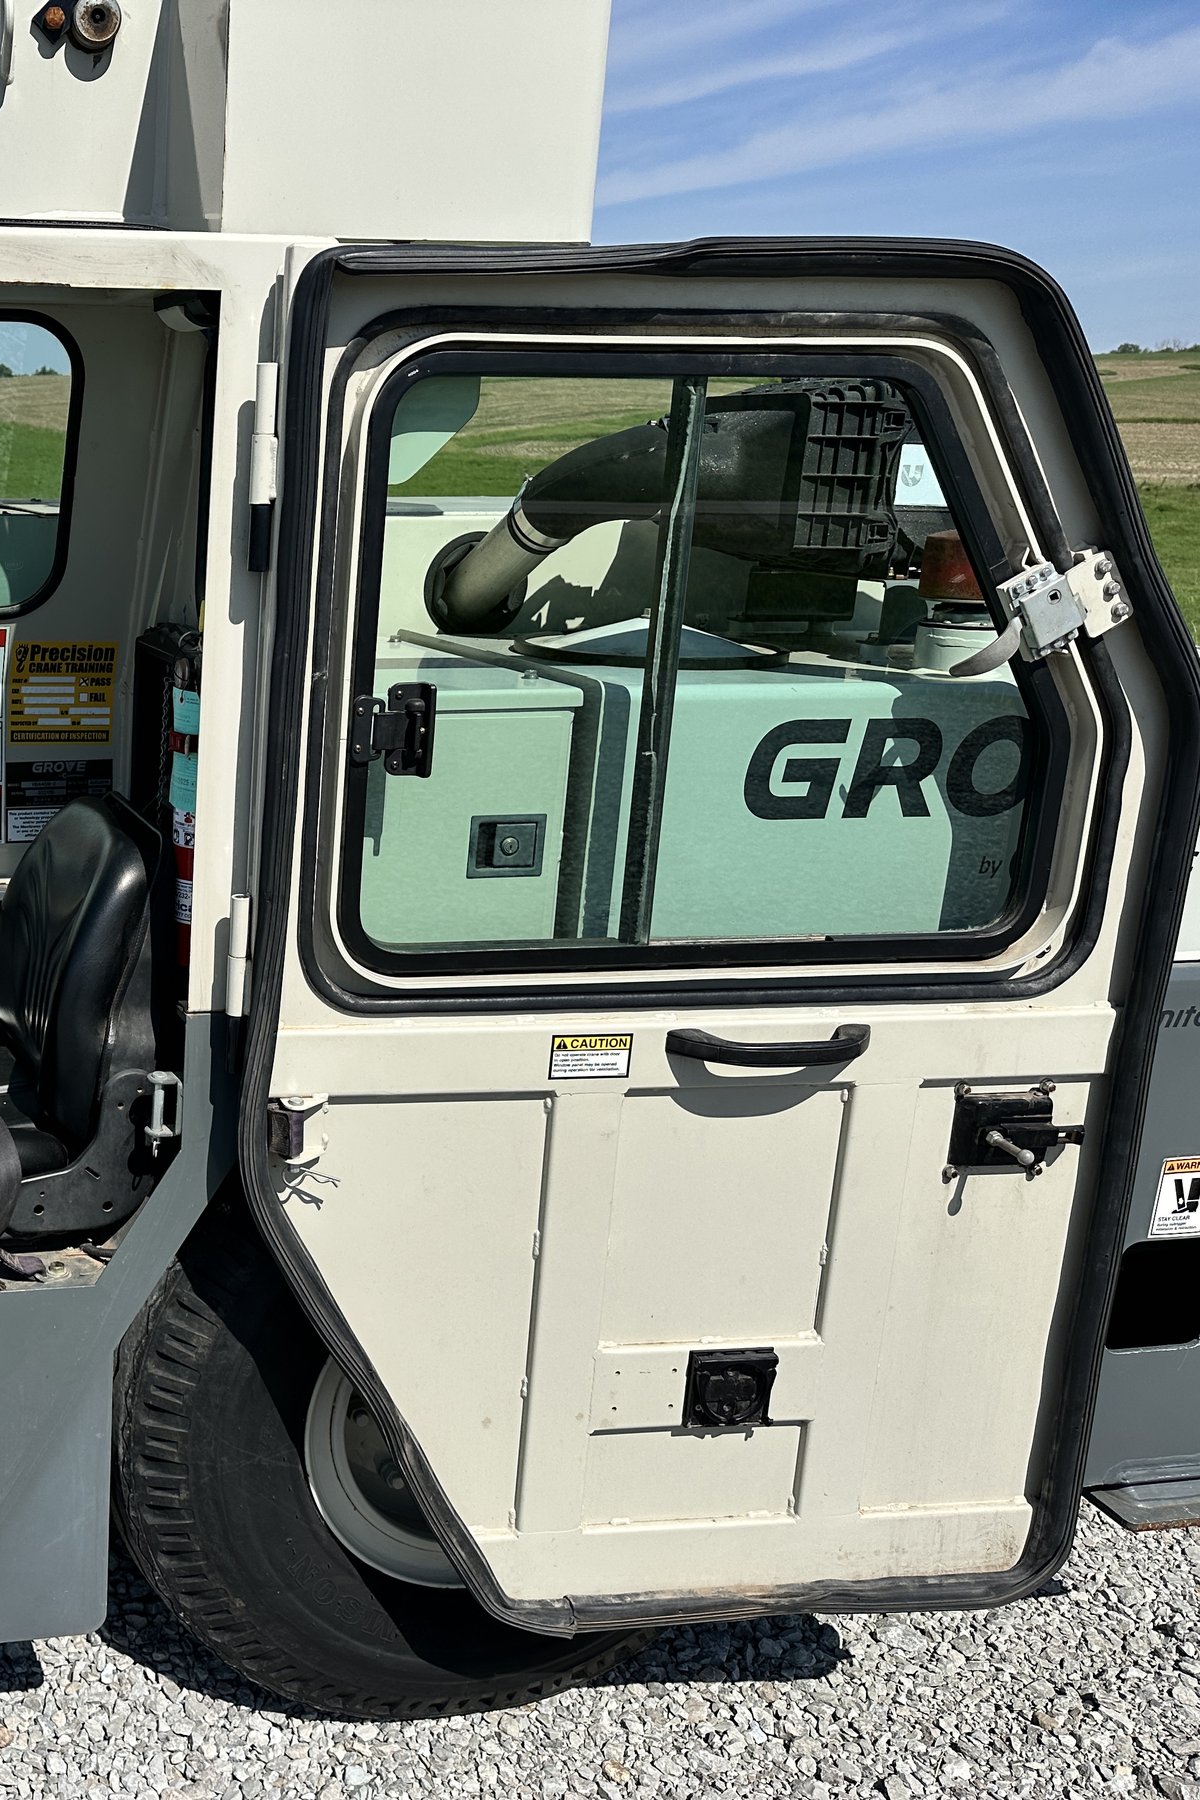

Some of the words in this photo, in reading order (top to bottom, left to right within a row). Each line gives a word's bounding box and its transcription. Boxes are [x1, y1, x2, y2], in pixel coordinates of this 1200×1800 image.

[30, 644, 116, 662] Precision
[28, 663, 62, 673] CRANE
[64, 663, 114, 673] TRAINING
[90, 678, 111, 686] PASS
[90, 693, 106, 702] FAIL
[32, 761, 87, 773] GROVE
[744, 715, 1031, 820] GRO
[978, 856, 1002, 878] by
[570, 1038, 627, 1048] CAUTION
